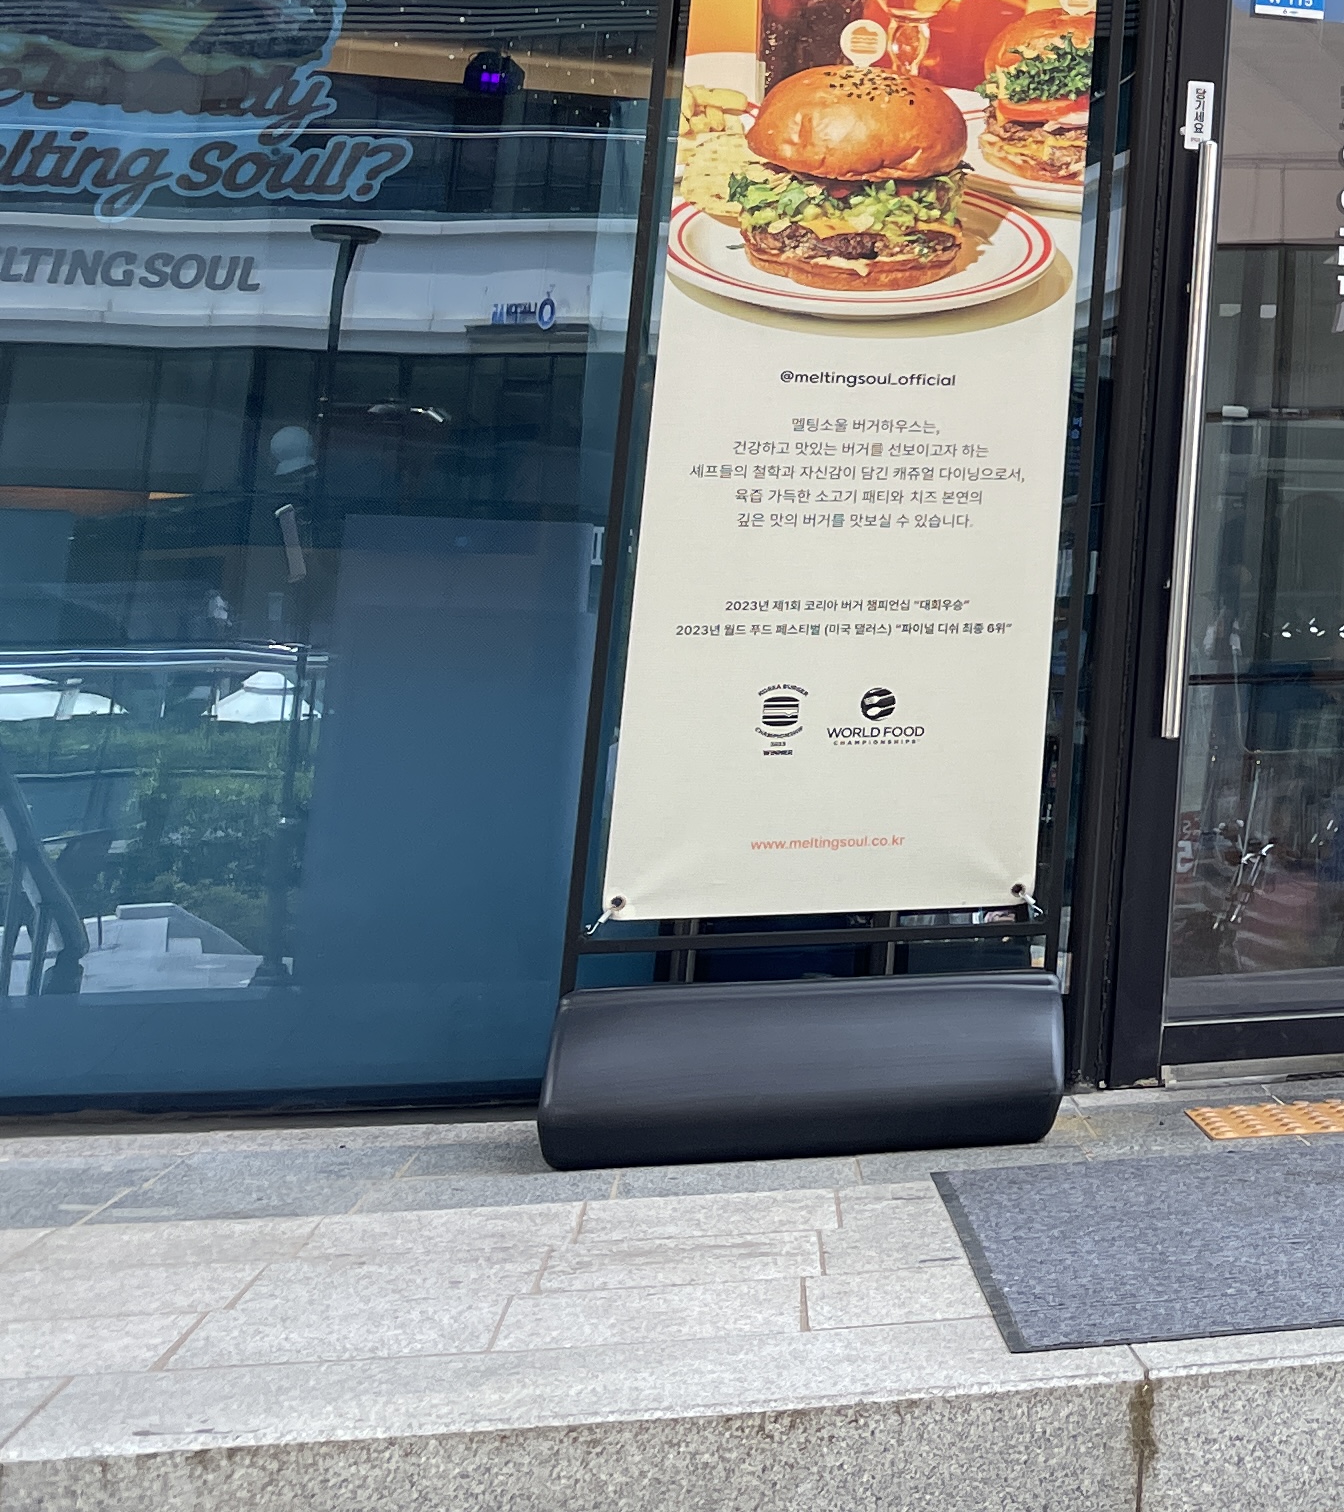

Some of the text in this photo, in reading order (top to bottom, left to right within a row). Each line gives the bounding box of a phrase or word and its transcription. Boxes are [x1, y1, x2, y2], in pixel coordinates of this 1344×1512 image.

[780, 370, 956, 387] @meltingsoul_official
[791, 417, 940, 435] 멜팅소울 버거하우스는,
[732, 440, 989, 458] 건강하고 맛있는 버거를 선보이고자 하는
[752, 465, 795, 480] 철학과
[799, 465, 856, 480] 자신감이
[861, 465, 889, 481] 담긴
[939, 467, 1025, 483] 다이닝으로서,
[735, 489, 983, 505] 육즙 가득한 소고기 패티와 치즈 본연의
[737, 513, 765, 528] 깊은
[770, 513, 797, 527] 맛의
[802, 513, 845, 528] 버거를
[849, 514, 892, 528] 맛보실
[896, 514, 909, 528] 수
[725, 600, 769, 612] 2023년
[772, 600, 801, 611] 제1회
[804, 600, 838, 611] 코리아
[841, 599, 863, 611] 버거
[867, 599, 911, 611] 챔피언십
[676, 624, 721, 636] 2023년
[724, 624, 747, 636] 월드
[749, 624, 773, 635] 푸드
[775, 624, 820, 636] 페스티벌
[824, 623, 851, 636] (미국
[854, 623, 892, 636] 댈러스)
[938, 623, 960, 634] 디쉬
[962, 622, 984, 635] 최종
[826, 726, 925, 738] WORLD FOOD
[750, 834, 905, 851] www.meltingsoul.co.kr
